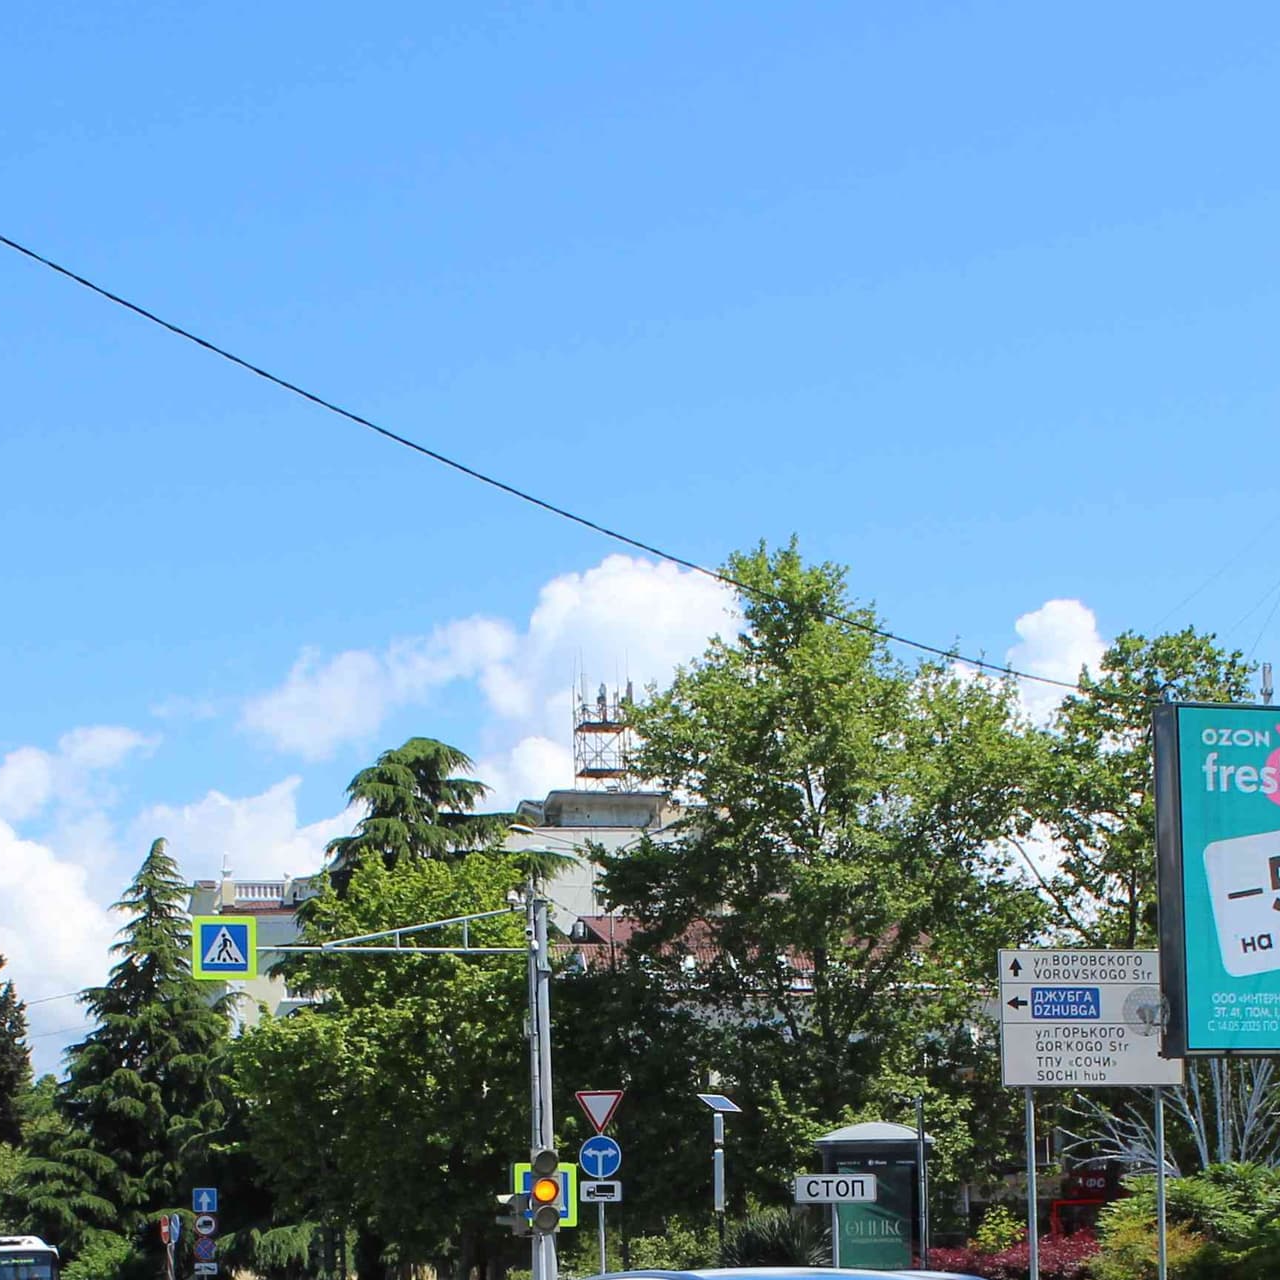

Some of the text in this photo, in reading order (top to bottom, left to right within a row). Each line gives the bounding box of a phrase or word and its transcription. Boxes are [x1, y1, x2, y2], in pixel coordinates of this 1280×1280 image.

[1201, 728, 1270, 747] OZON
[1241, 931, 1272, 953] на
[1034, 969, 1152, 980] VOROVSKOGO Str
[1034, 991, 1093, 1003] ДЖУБГА
[1212, 993, 1236, 1004] ООО
[1034, 1005, 1097, 1016] DZHUBGA
[1109, 1041, 1129, 1052] Str
[1036, 1057, 1117, 1067] ТПУ «СОЧИ»
[1037, 1070, 1106, 1081] SOCHI hub
[807, 1180, 865, 1197] СТОП
